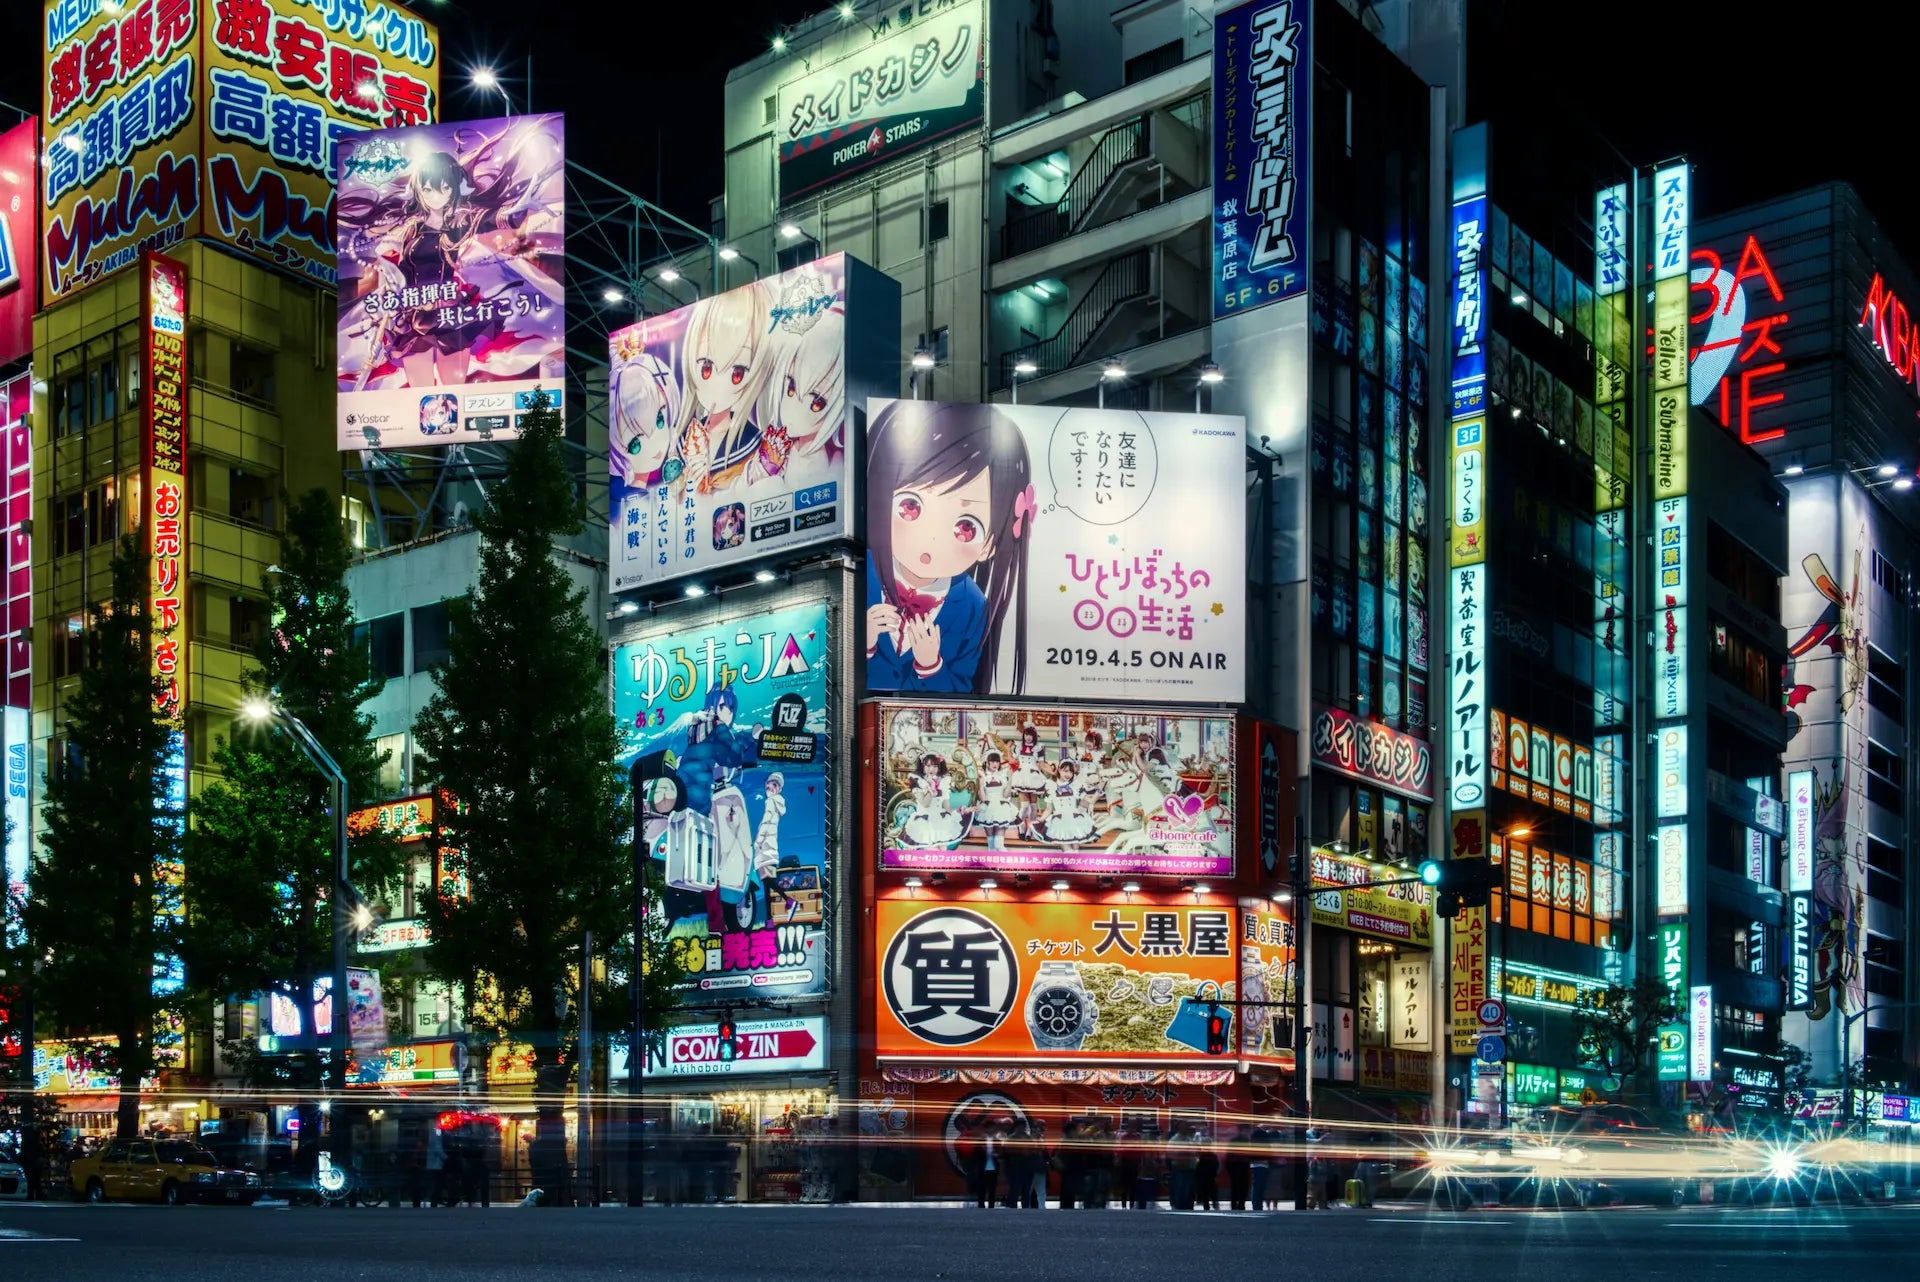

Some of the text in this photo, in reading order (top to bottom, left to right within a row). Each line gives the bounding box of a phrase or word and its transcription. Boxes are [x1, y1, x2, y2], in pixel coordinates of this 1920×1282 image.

[49, 0, 193, 120] 激安販売
[789, 24, 972, 141] メイドカジノ
[210, 67, 338, 182] 高額
[833, 118, 921, 165] POKER STARS
[46, 153, 198, 296] Mulan
[1222, 198, 1238, 281] 秋葉原店
[1662, 176, 1684, 268] スーパービル
[234, 229, 305, 269] ムーラン
[60, 261, 103, 296] ムーラン
[103, 246, 136, 274] AKIBA
[364, 280, 468, 314] さあ指揮官、
[153, 315, 182, 333] あなたの
[154, 333, 182, 352] DVD
[1659, 326, 1677, 383] Yellow
[153, 365, 182, 384] ゲーム
[158, 380, 178, 396] CD
[153, 393, 182, 413] アイドル
[153, 408, 182, 427] アニメ
[357, 412, 391, 424] Yostar
[467, 397, 505, 410] アズレン
[154, 424, 181, 443] コミック
[154, 442, 181, 457] ホビー
[1459, 426, 1480, 441] 3F
[1659, 396, 1678, 489] Submarine
[153, 455, 181, 475] フィギュア
[1095, 429, 1113, 505] なりたい
[1118, 430, 1137, 489] 友達に
[813, 488, 831, 501] 検索
[1463, 455, 1476, 523] りらくる
[1662, 500, 1680, 513] 5F
[656, 486, 669, 565] 望んでいる
[683, 478, 697, 559] これが君の
[753, 499, 788, 517] アズレン
[1064, 549, 1211, 600] ひとりぼっちの
[1045, 647, 1227, 670] 2019.4.5 ON AIR
[1314, 712, 1430, 790] メイドカジノ
[10, 743, 26, 798] SEGA
[1150, 830, 1217, 842] @home cafe
[1453, 819, 1482, 857] 免
[1027, 940, 1085, 956] チケット
[1093, 910, 1230, 956] 大黒屋
[1794, 896, 1809, 1006] GALLERIA
[899, 928, 1005, 1028] 質
[1404, 977, 1419, 1040] ルノアール
[1482, 1007, 1499, 1019] 40
[749, 1033, 779, 1057] ZIN
[673, 1063, 731, 1074] Akihabara
[1516, 1073, 1556, 1094] リバティー
[1102, 1085, 1179, 1103] チケット
